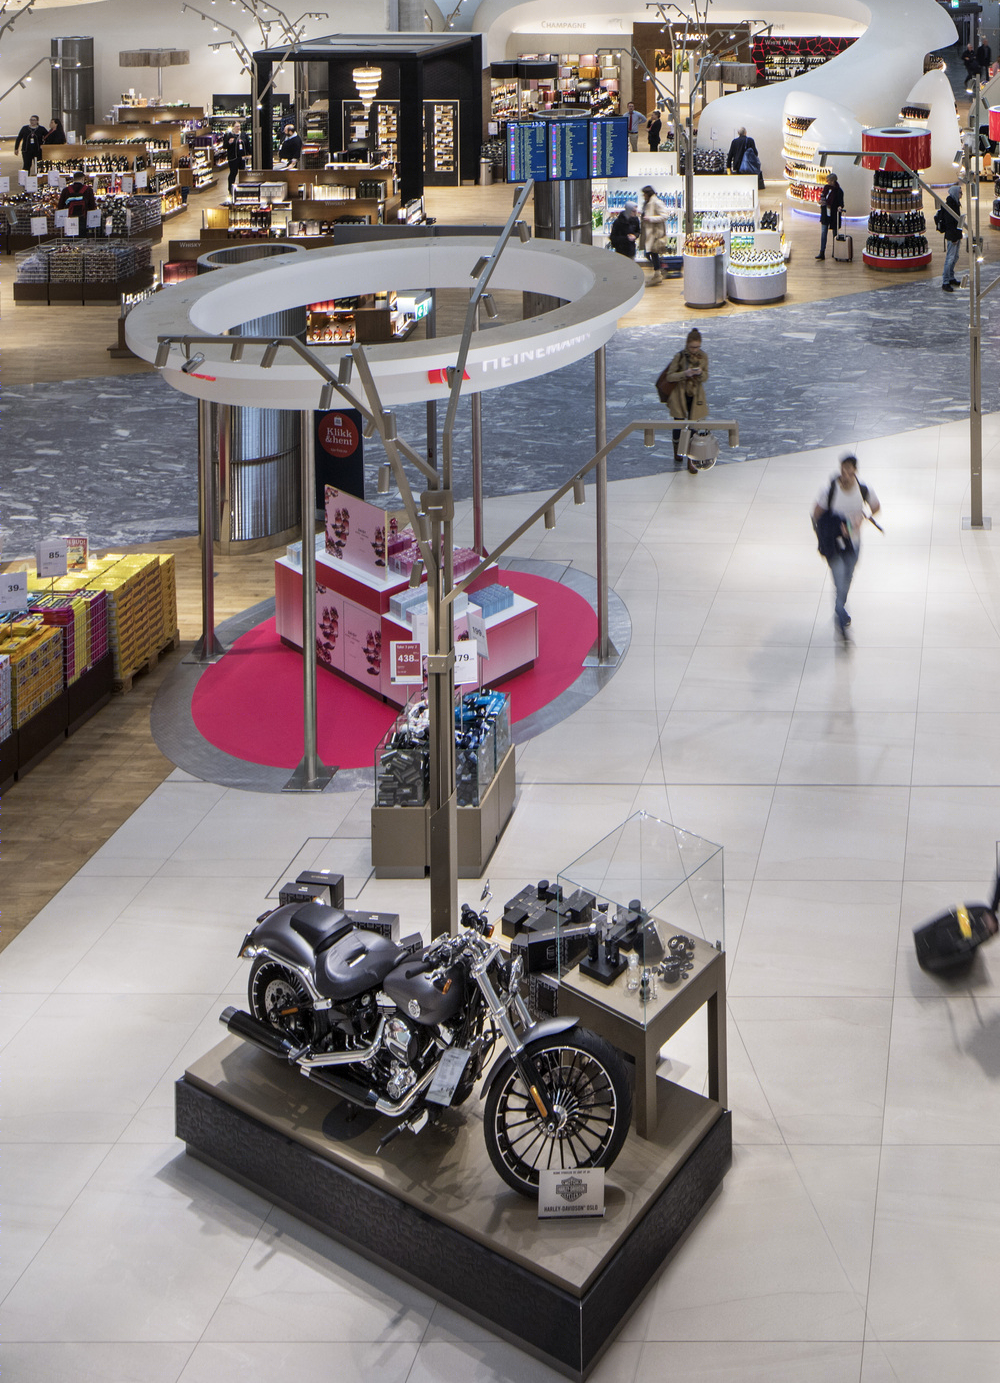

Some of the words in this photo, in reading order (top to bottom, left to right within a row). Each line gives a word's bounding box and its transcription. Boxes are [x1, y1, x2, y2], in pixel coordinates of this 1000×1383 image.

[326, 427, 352, 438] Klikk
[48, 551, 60, 559] 85
[7, 584, 20, 592] 39
[397, 654, 415, 663] 438
